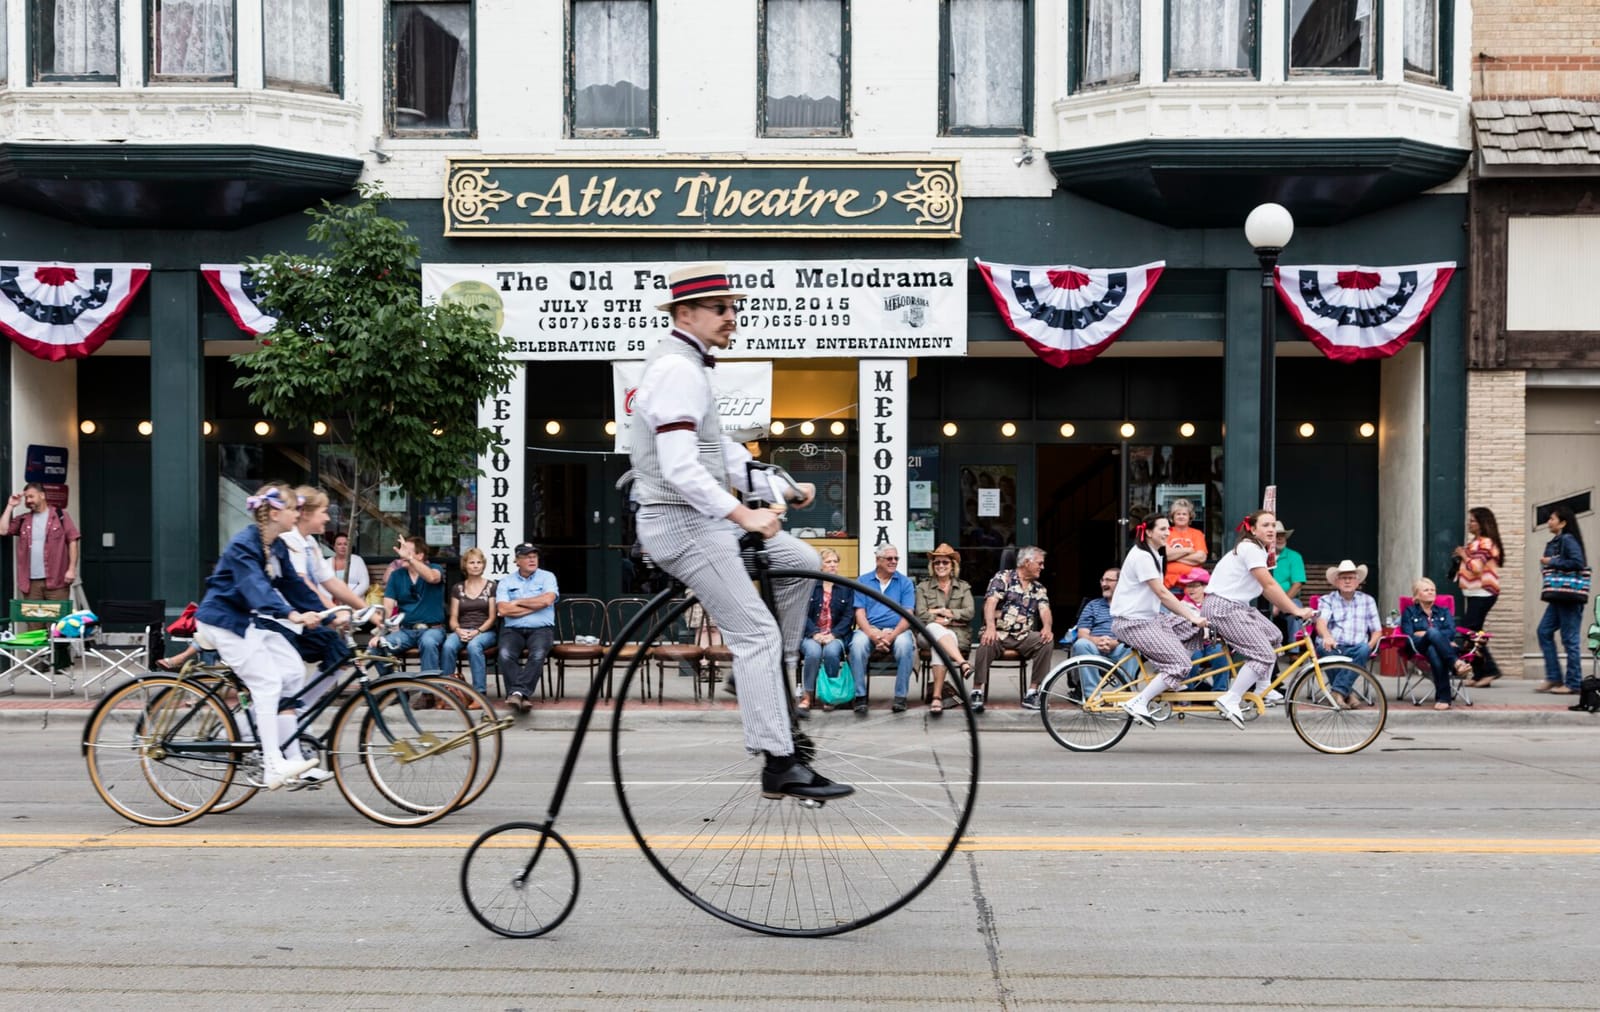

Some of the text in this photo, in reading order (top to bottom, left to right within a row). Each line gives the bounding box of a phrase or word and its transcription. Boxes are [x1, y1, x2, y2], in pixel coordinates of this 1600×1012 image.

[516, 172, 888, 218] Atlas Theatre
[496, 271, 548, 291] The
[569, 270, 614, 291] Old
[795, 267, 954, 288] Melodrama
[539, 299, 589, 313] JULY
[603, 299, 642, 313] 9TH
[884, 295, 930, 312] MELODRAMA
[538, 313, 850, 331] (307)638-6543 07)635-0199
[627, 340, 645, 352] 59
[746, 338, 807, 350] FAMILY
[816, 337, 953, 350] ENTERTAINMENT
[873, 370, 894, 548] MELODRA
[908, 455, 922, 468] 211
[490, 383, 512, 582] ELODRAM
